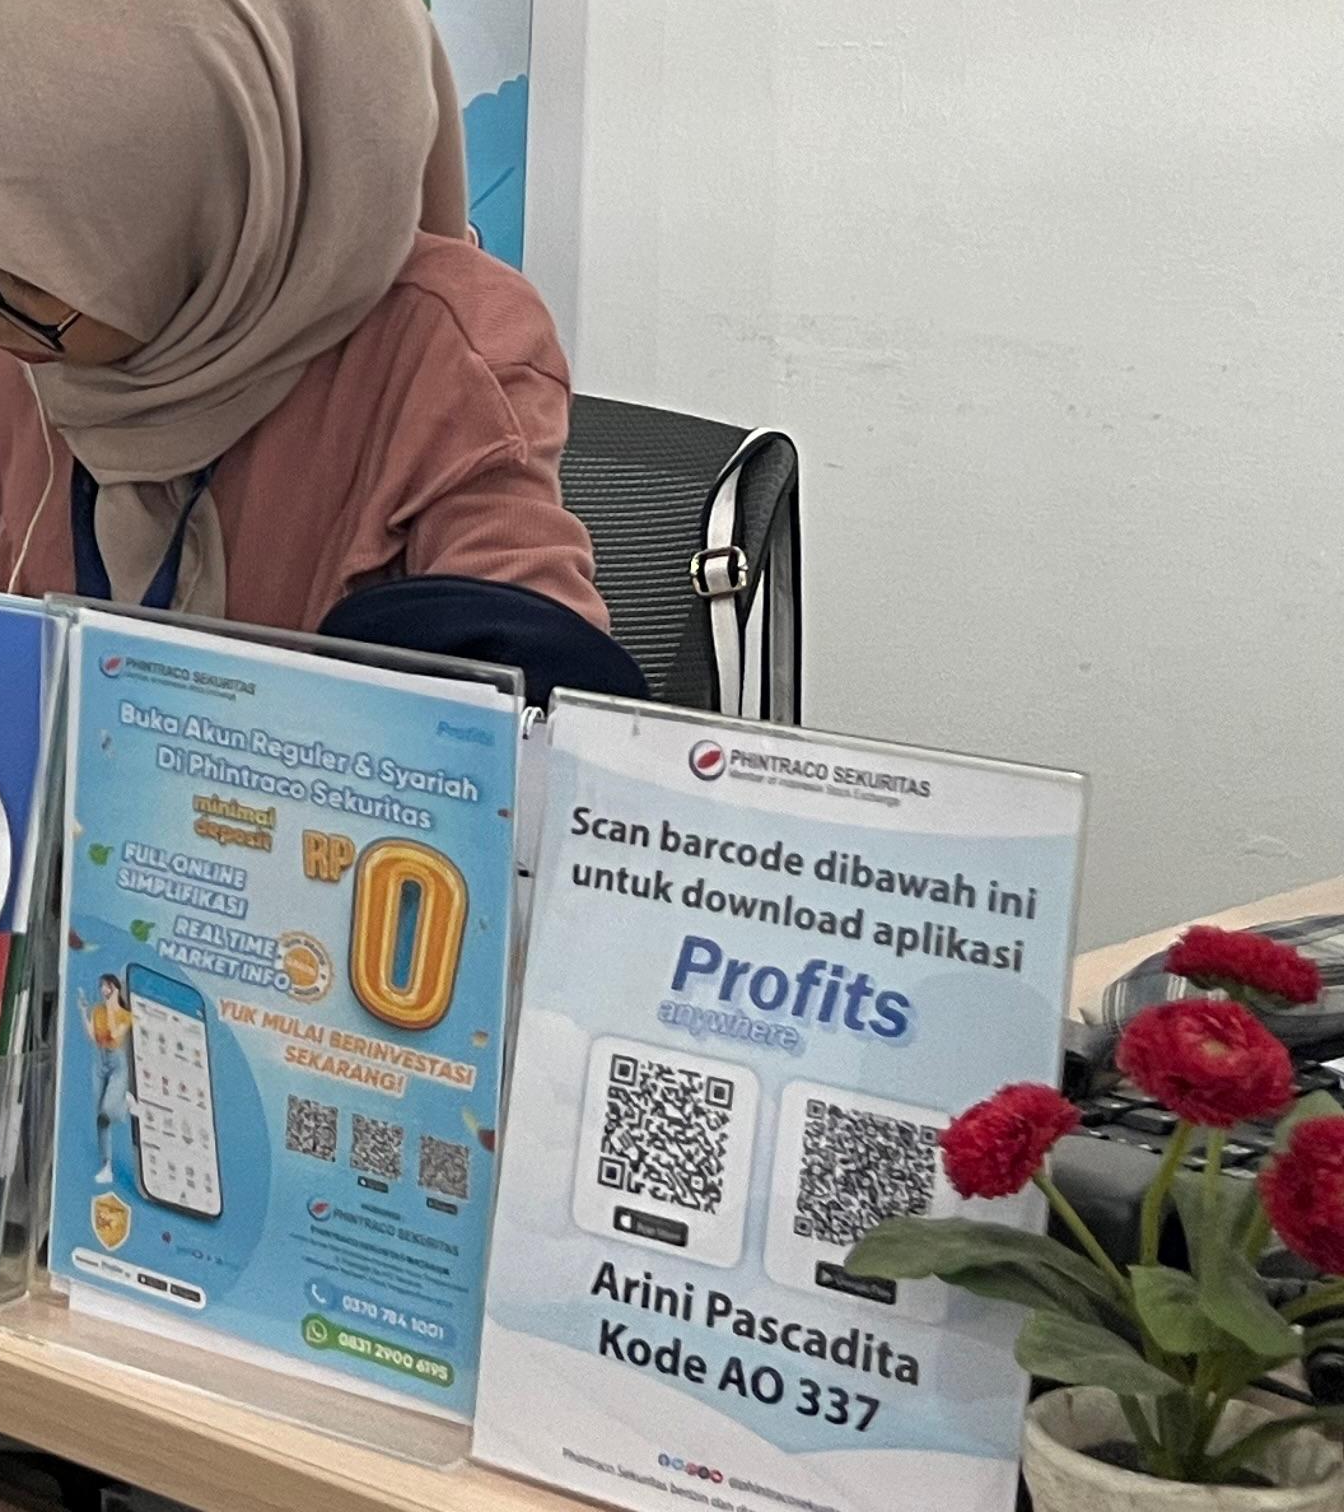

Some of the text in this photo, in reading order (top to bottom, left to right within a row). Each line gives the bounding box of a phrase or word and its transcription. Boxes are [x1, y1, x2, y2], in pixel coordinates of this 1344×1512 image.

[119, 702, 479, 803] Buka Akun Reguler & Syariah
[729, 749, 829, 781] PHINTRACO
[832, 764, 931, 798] SEKURITAS
[156, 747, 433, 830] Di Phintraco Sekuritas
[193, 794, 277, 829] minimal
[122, 840, 247, 890] FULL ONLINE
[193, 816, 273, 853] deposit
[571, 806, 1039, 921] Scan barcode dibawah ini
[116, 868, 248, 918] SIMPLIFIKASI
[572, 862, 1025, 973] untuk download aplikasi
[174, 915, 279, 960] REAL TIME
[302, 829, 357, 885] RP
[349, 836, 470, 1031] 0
[158, 941, 238, 980] MARKET
[238, 960, 291, 992] INFO
[670, 934, 913, 1041] Profits
[218, 998, 476, 1088] YUK MULAI BERINVESTASI
[657, 997, 802, 1053] anywhere
[284, 1044, 407, 1096] SEKARANG!
[590, 1260, 921, 1387] Arini Pascadita
[599, 1319, 881, 1433] Kode AO 337
